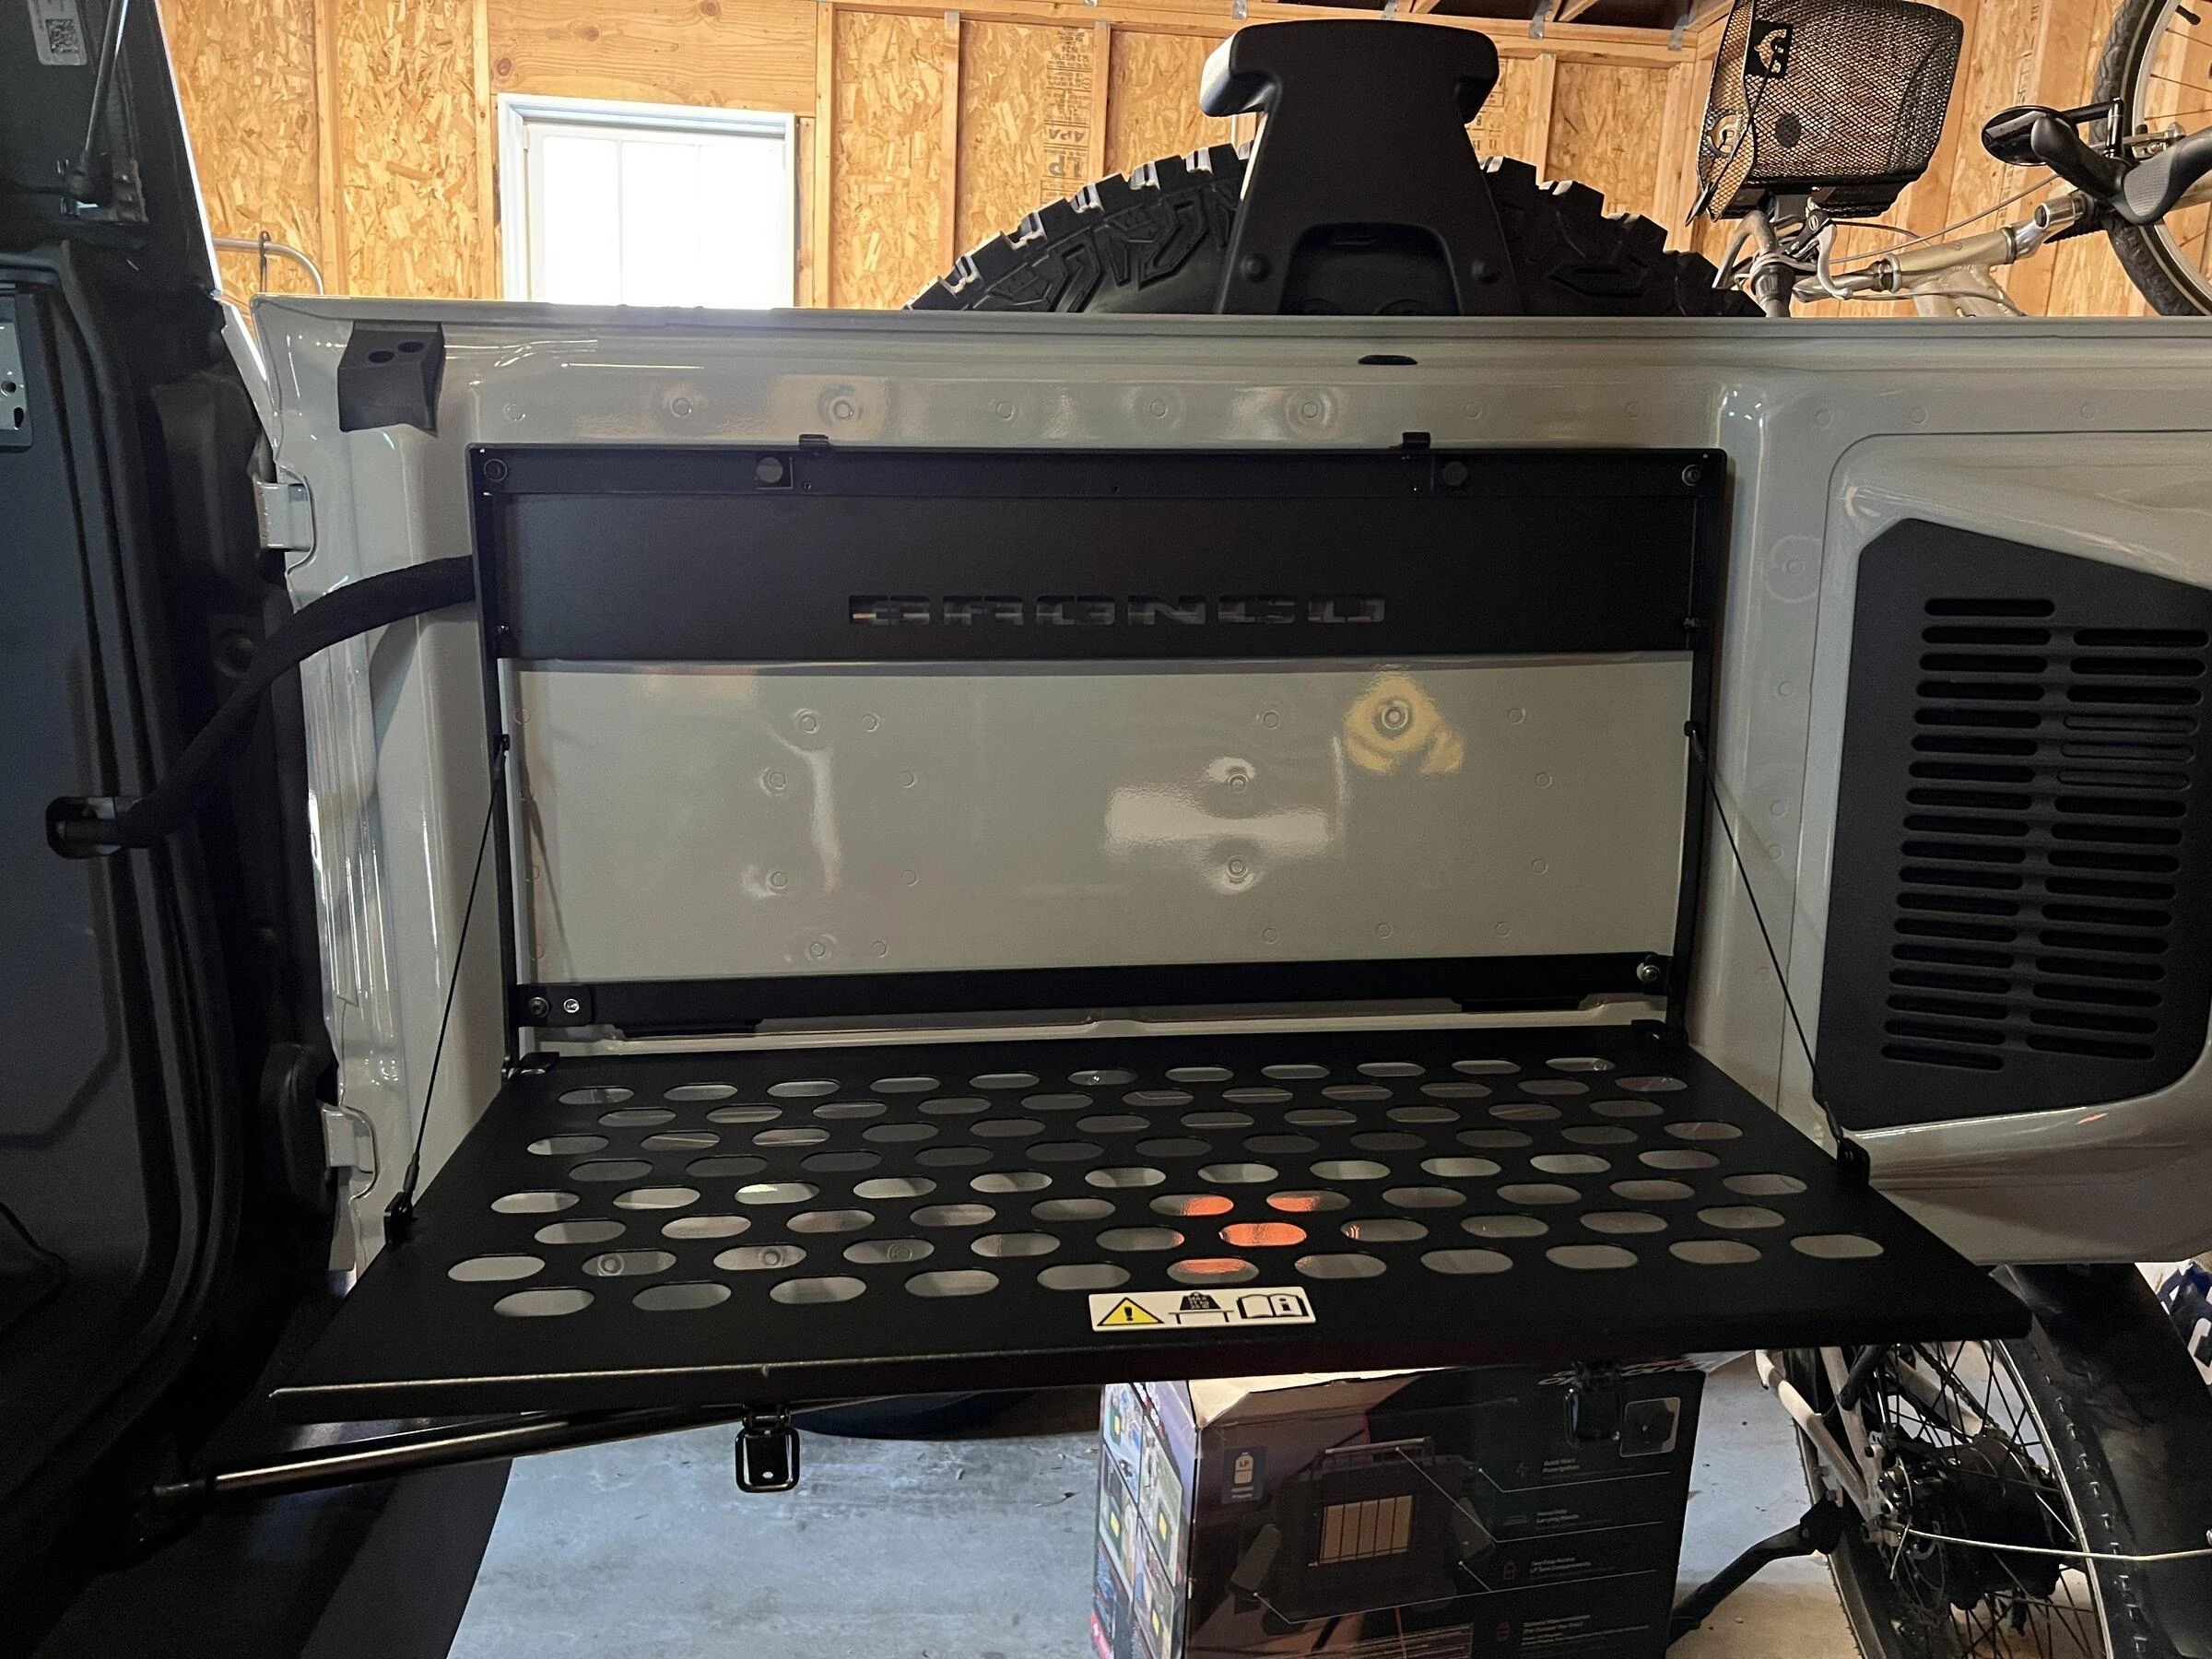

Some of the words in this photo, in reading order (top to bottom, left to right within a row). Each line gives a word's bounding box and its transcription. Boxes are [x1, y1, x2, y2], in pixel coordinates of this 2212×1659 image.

[1049, 129, 1085, 143] APA
[1048, 155, 1081, 179] LP
[848, 594, 1385, 626] BRONCO
